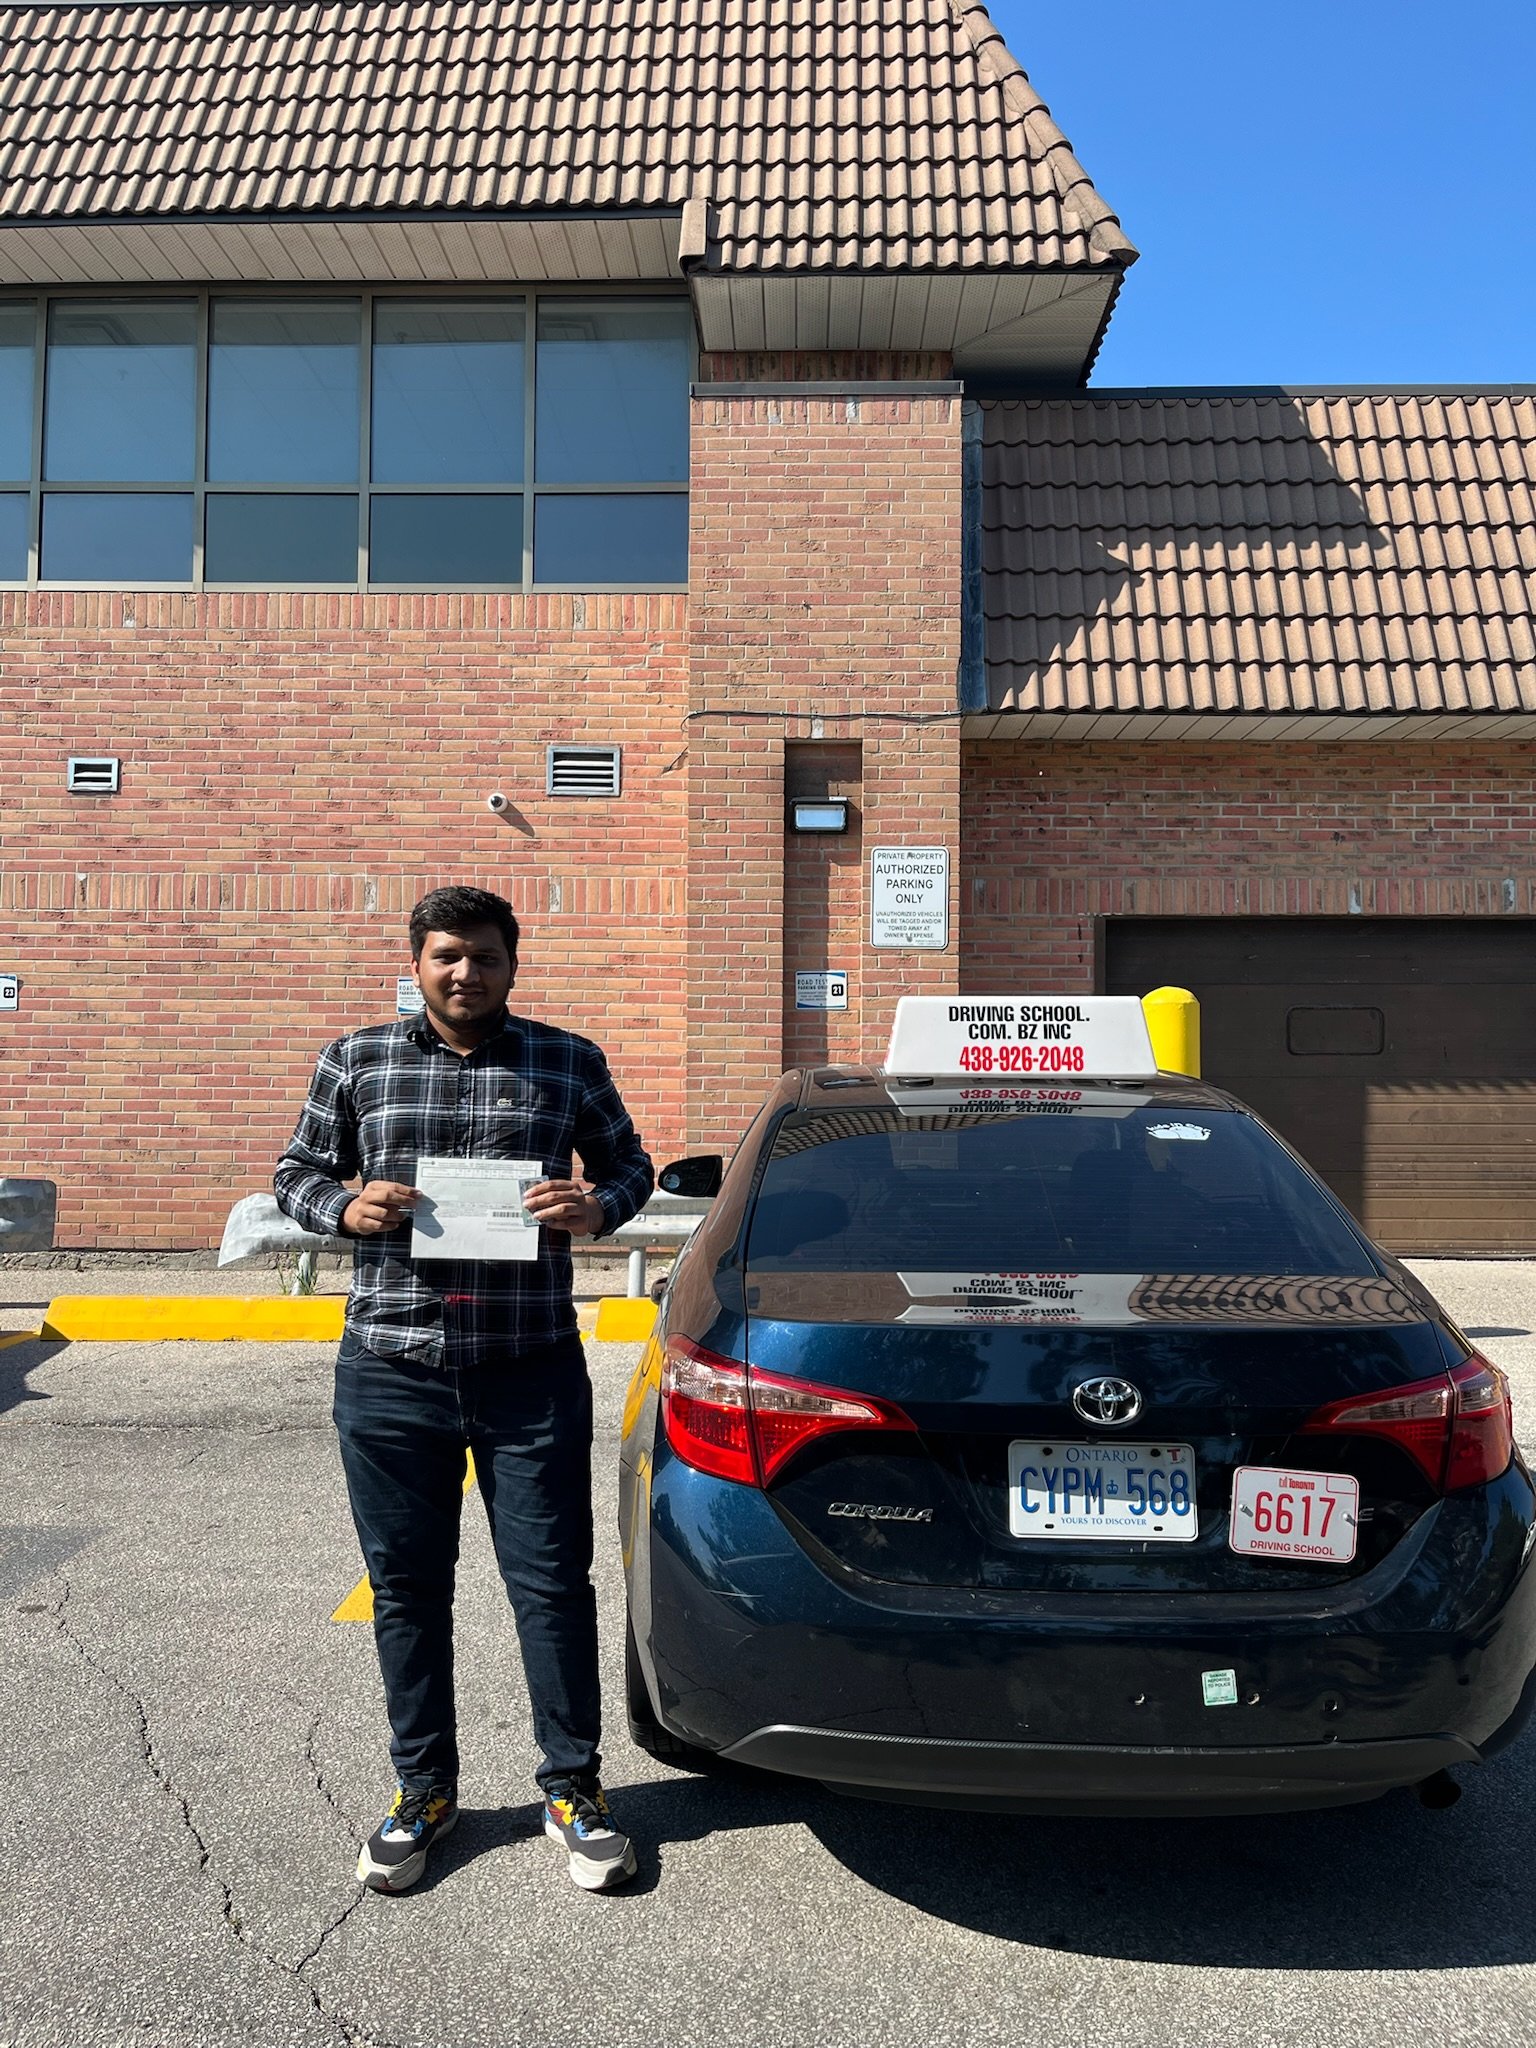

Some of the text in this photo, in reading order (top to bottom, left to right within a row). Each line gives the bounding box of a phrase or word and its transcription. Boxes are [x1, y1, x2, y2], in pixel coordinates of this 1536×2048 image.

[877, 852, 943, 860] PRIVATE PROPERTY
[876, 864, 944, 875] AUTHORIZED
[886, 879, 934, 889] PARKING
[895, 893, 924, 904] ONLY
[4, 988, 14, 997] 23
[832, 985, 842, 995] 21
[948, 1005, 1090, 1022] DRIVING SCHOOL.
[968, 1023, 1071, 1040] COM. BZ INC
[959, 1046, 1084, 1072] 438-926-2048
[1066, 1448, 1138, 1464] ONTARIO
[1020, 1466, 1191, 1516] CYPM 568
[1289, 1478, 1315, 1491] TORONTO
[827, 1502, 934, 1522] COROLLA
[1255, 1491, 1336, 1538] 6617
[1060, 1517, 1147, 1526] YOURS TO DISCOVER
[1250, 1540, 1335, 1556] DRIVING SCHOOL
